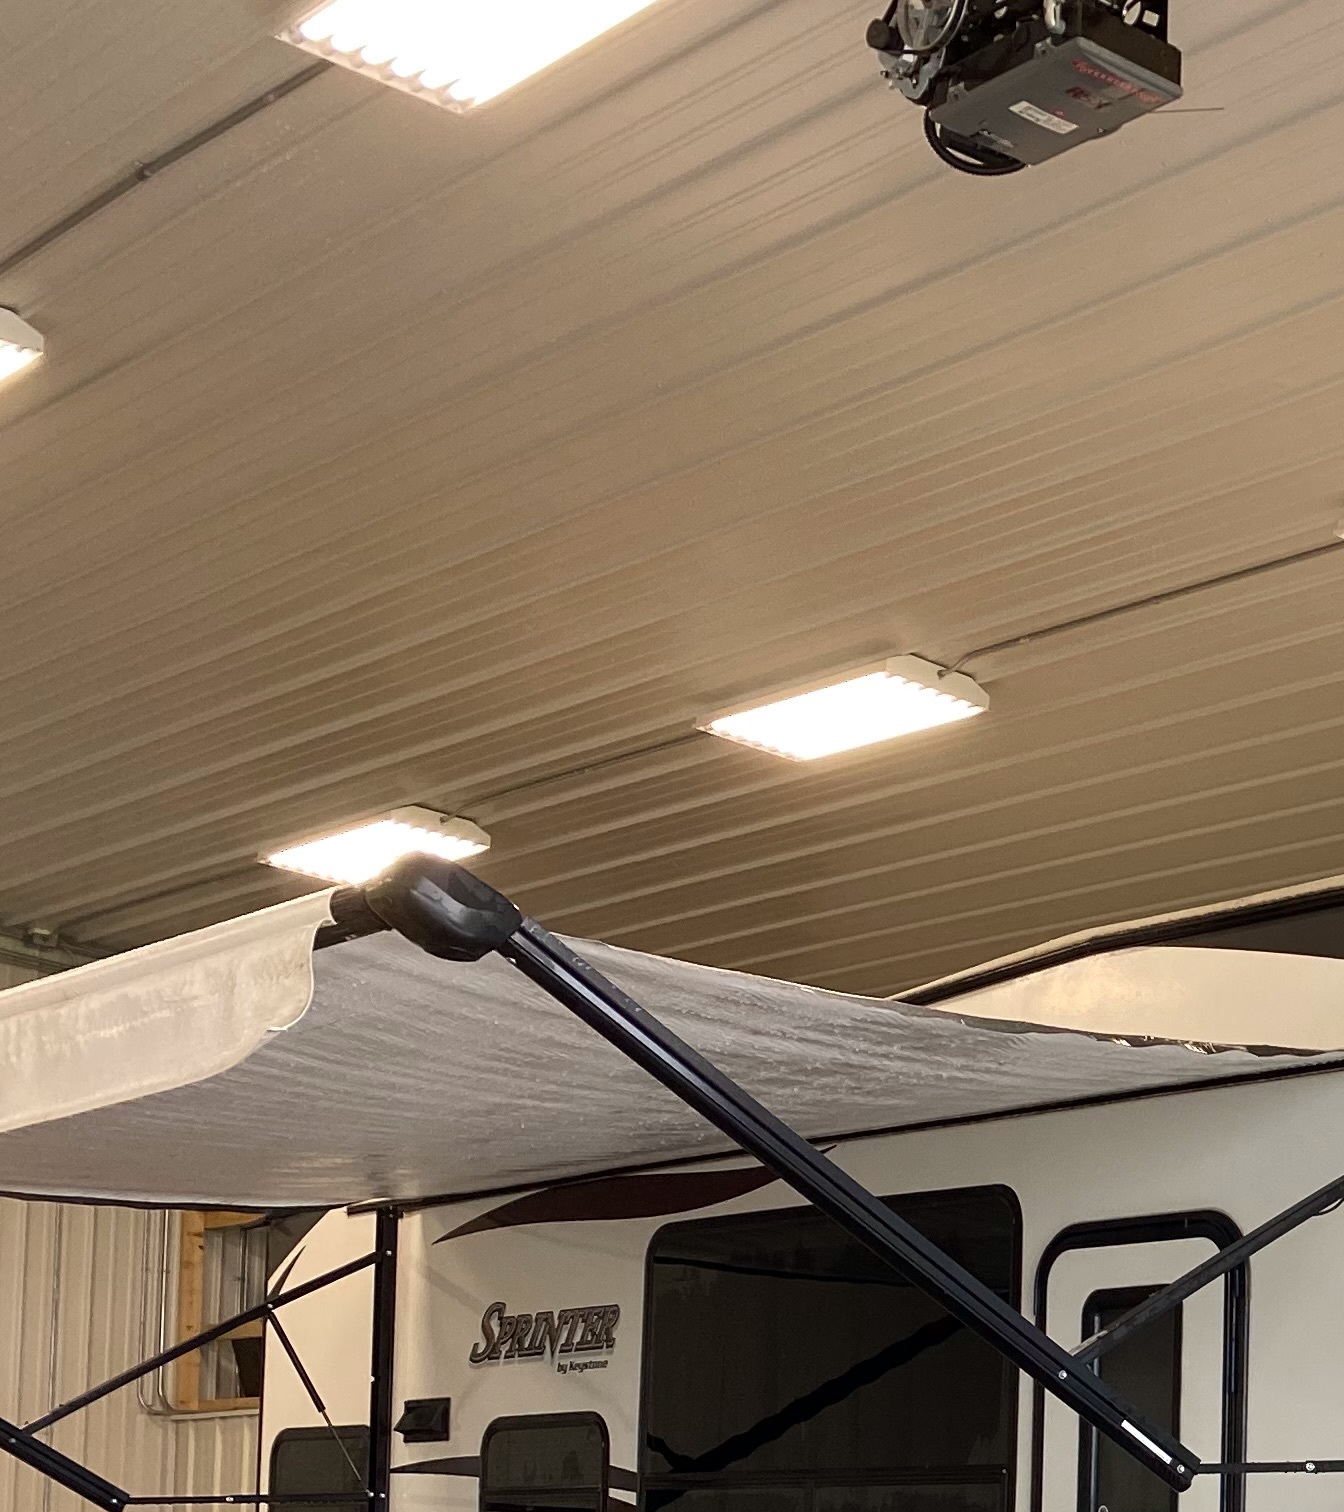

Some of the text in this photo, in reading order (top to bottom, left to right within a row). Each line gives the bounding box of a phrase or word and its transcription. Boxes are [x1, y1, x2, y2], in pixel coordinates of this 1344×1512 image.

[469, 1302, 620, 1364] SPRINTER
[557, 1359, 609, 1374] by Keystone
